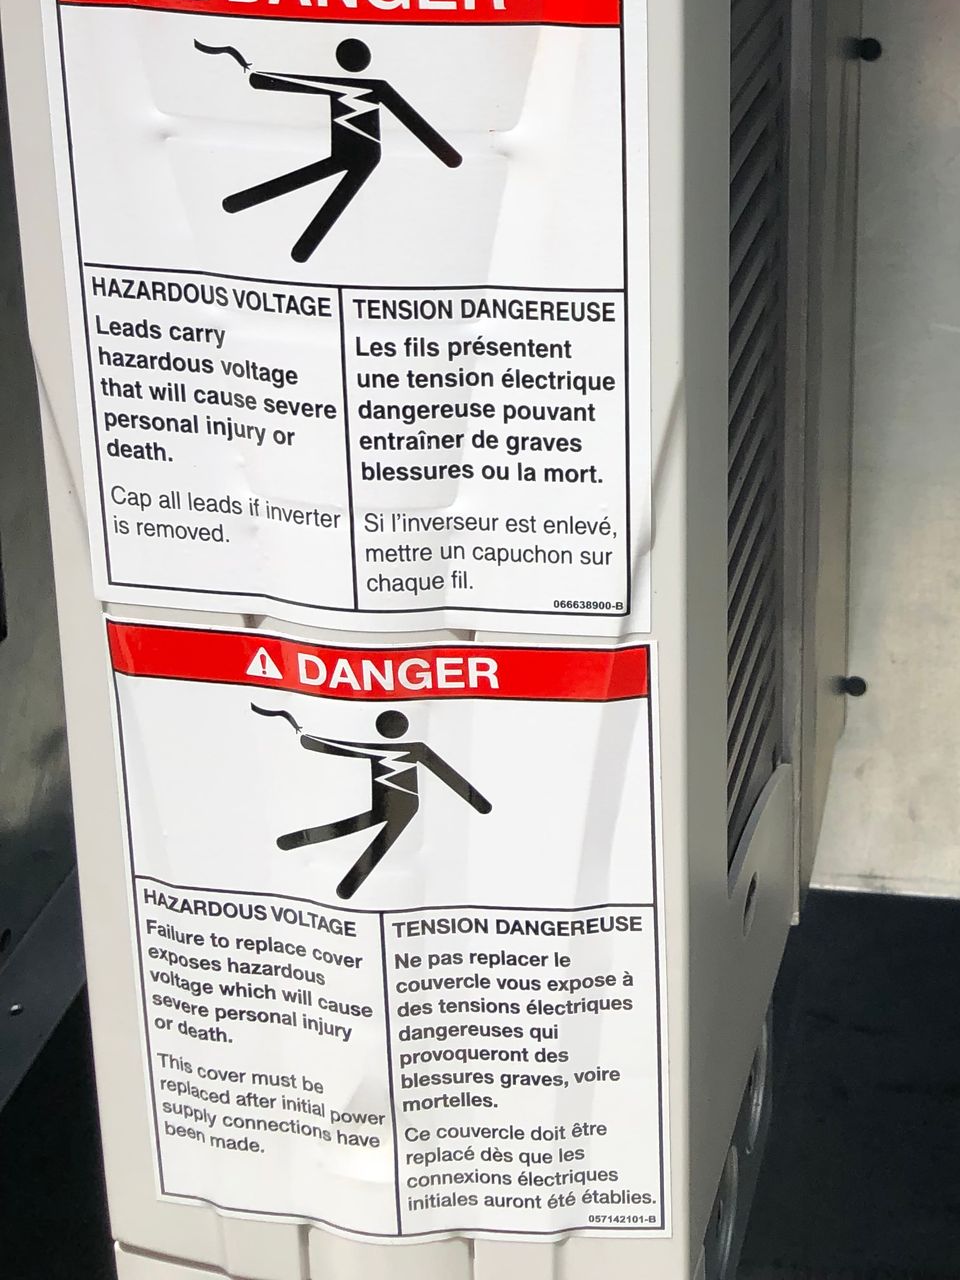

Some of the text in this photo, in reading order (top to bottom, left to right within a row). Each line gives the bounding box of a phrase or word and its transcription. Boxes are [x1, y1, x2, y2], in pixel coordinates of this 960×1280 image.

[91, 275, 333, 318] HAZARDOUS VOLTAGE
[352, 297, 616, 323] TENSION DANGEREUSE
[95, 314, 226, 350] Leads carry
[355, 335, 573, 362] Les fils présentent
[97, 345, 299, 389] hazardous voltage
[356, 367, 616, 396] une tension électrique
[99, 377, 338, 420] that will cause severe
[357, 399, 596, 426] dangereuse pouvant
[103, 411, 296, 447] personal injury or
[359, 429, 583, 456] entraîner de graves
[106, 437, 174, 463] death.
[361, 461, 603, 484] blessures ou la mort.
[113, 514, 230, 543] is removed.
[553, 599, 624, 611] 066638900-B
[297, 653, 500, 692] DANGER
[143, 887, 357, 938] HAZARDOUS VOLTAGE
[391, 915, 643, 939] TENSION DANGEREUSE
[147, 946, 326, 986] exposes hazardous
[151, 993, 353, 1043] severe personal injury
[154, 1017, 233, 1044] or death.
[398, 1023, 559, 1043] dangereuses qui
[399, 1047, 569, 1070] provoqueront des
[402, 1091, 499, 1113] mortelles.
[162, 1101, 381, 1149] supply connections have
[164, 1120, 265, 1154] been made.
[406, 1168, 619, 1189] connexions électriques
[407, 1188, 657, 1212] initiales auront été établies.
[588, 1214, 657, 1224] 057142101-B
